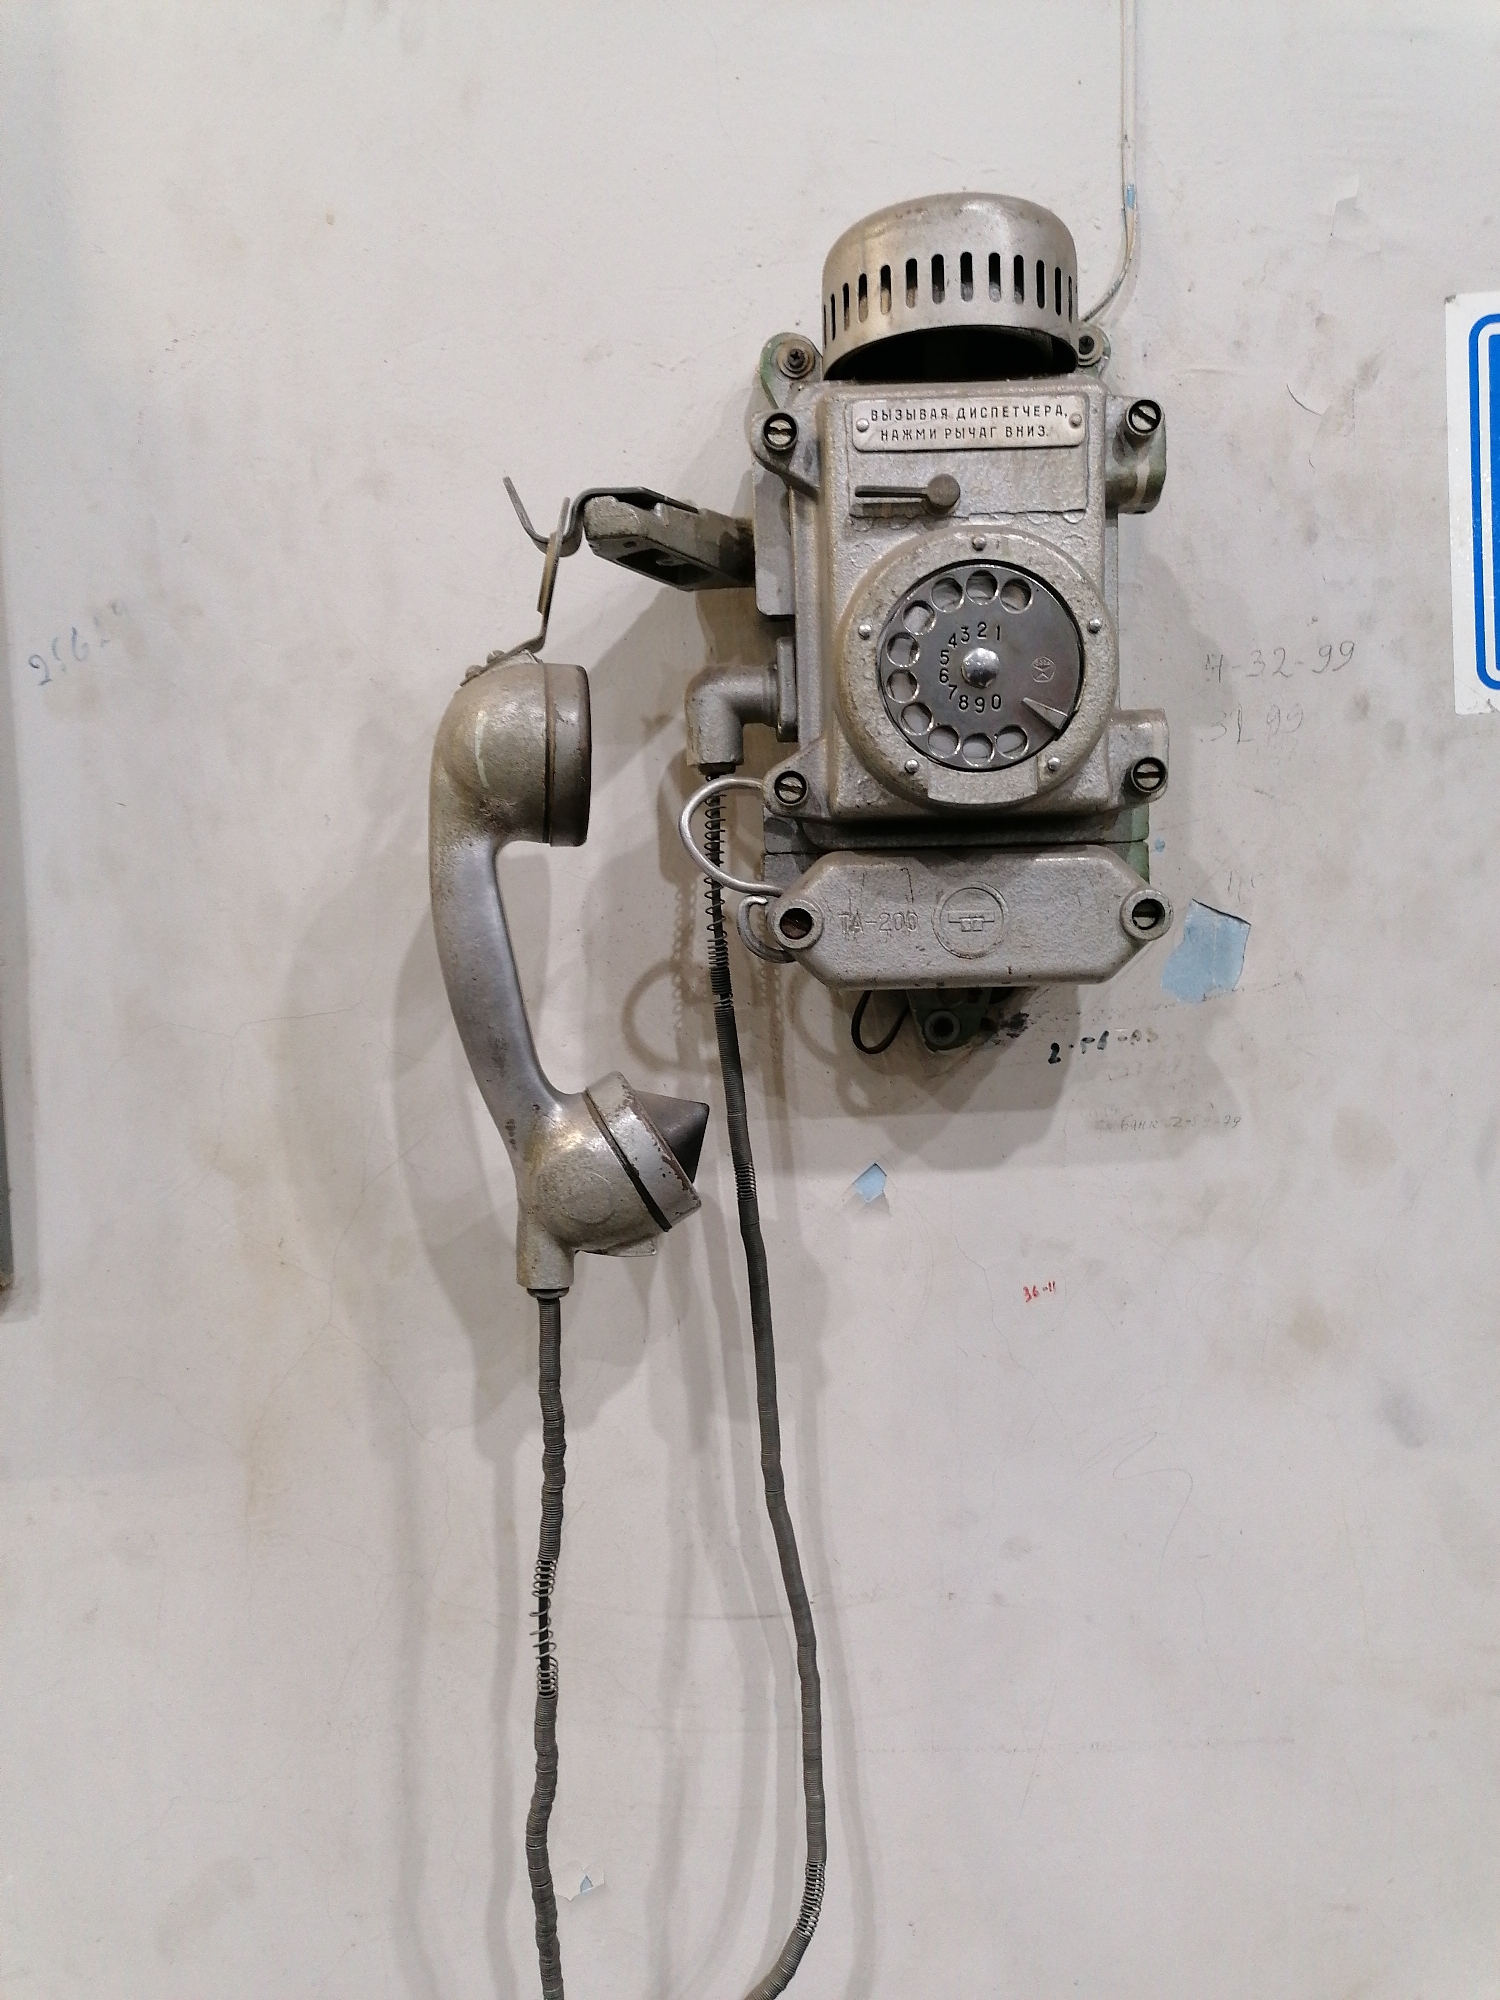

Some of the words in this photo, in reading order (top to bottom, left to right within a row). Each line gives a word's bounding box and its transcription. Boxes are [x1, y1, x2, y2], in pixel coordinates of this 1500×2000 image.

[871, 404, 949, 422] ВЫЗЫВАЯ
[956, 404, 1068, 421] ДИСПЕТЧЕРА,
[881, 427, 938, 441] НАЖМИ
[945, 426, 997, 439] РЫЧАГ
[1005, 426, 1049, 438] ВНИЗ.
[960, 626, 971, 643] 3
[976, 622, 988, 640] 2
[996, 625, 1001, 641] 1
[948, 632, 957, 649] 4
[940, 649, 950, 666] 5
[939, 668, 950, 685] 6
[949, 685, 959, 700] 7
[959, 694, 970, 712] 8
[975, 697, 986, 714] 9
[991, 694, 1002, 711] 0
